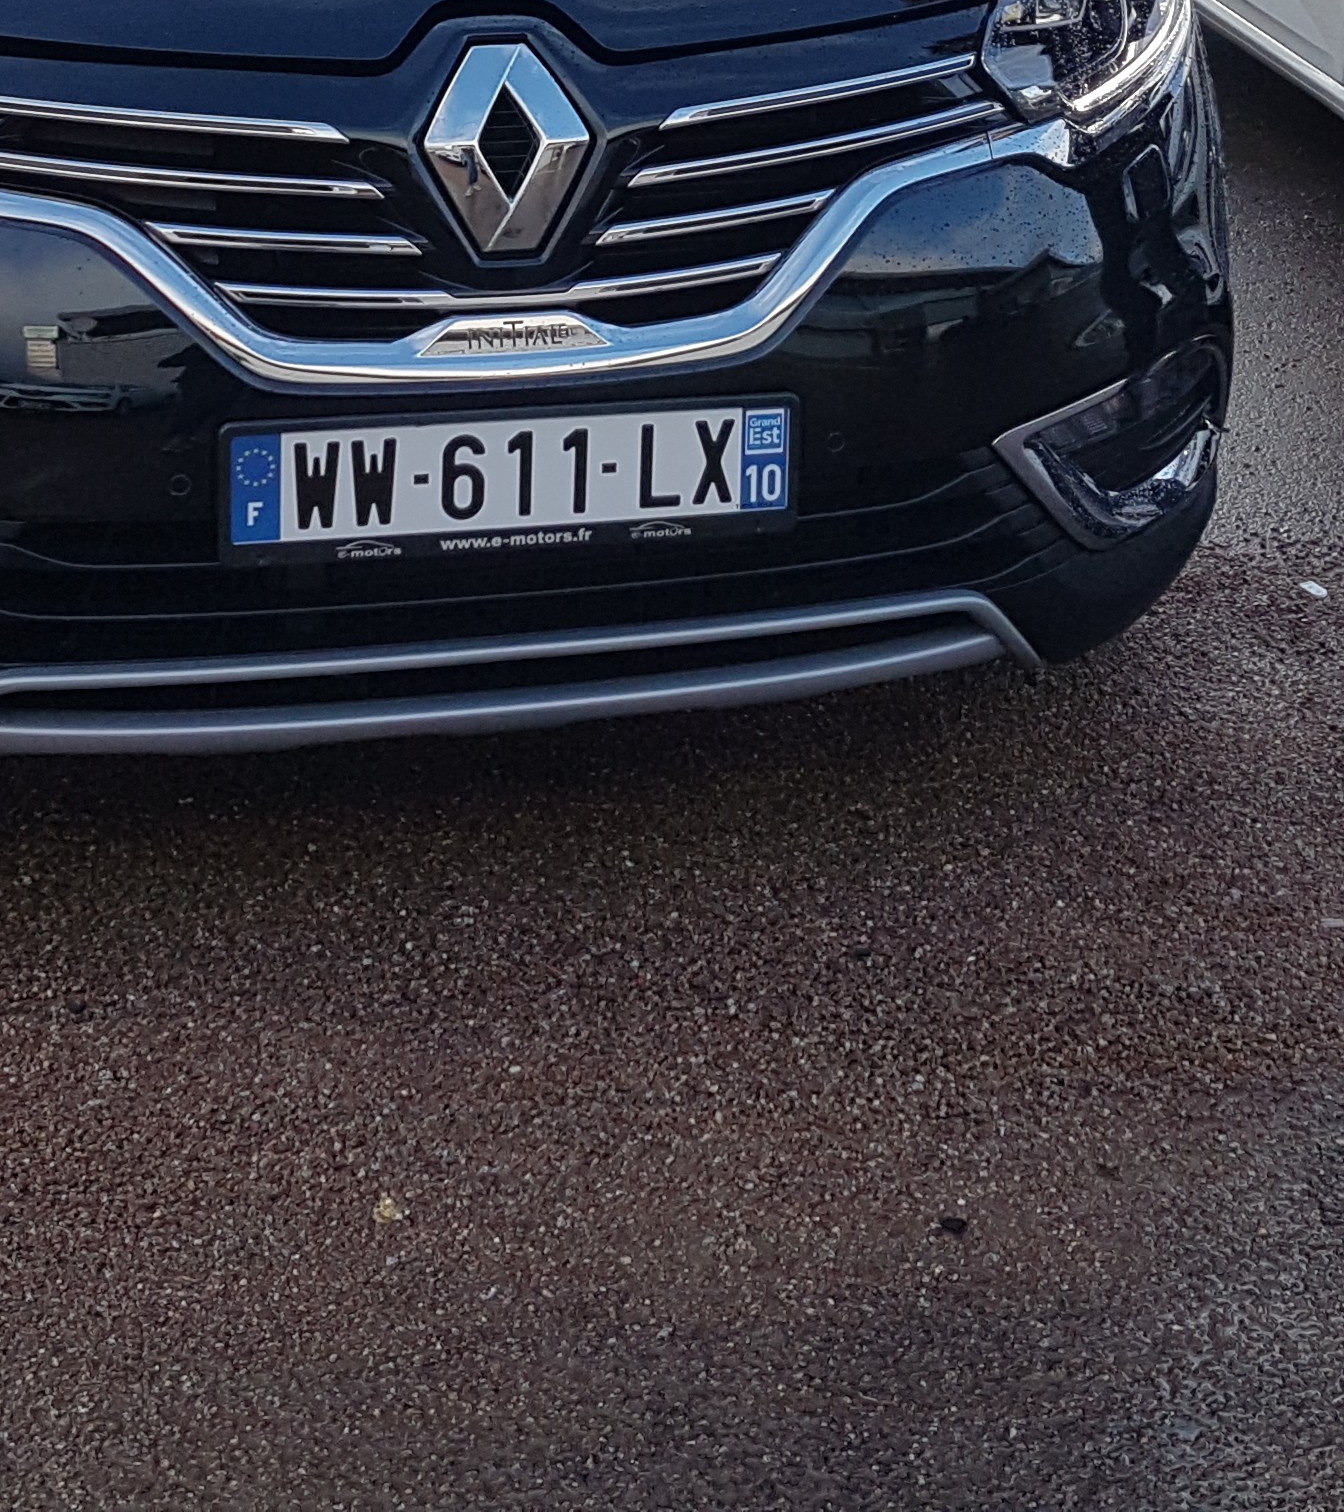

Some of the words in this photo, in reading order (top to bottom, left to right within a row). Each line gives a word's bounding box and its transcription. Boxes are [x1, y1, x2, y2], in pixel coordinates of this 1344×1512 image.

[750, 416, 781, 427] Grand
[749, 427, 781, 445] Est
[293, 418, 736, 530] WW-611-LX
[745, 463, 782, 503] 10
[246, 502, 264, 527] F
[440, 528, 593, 552] www.e-motors.fr
